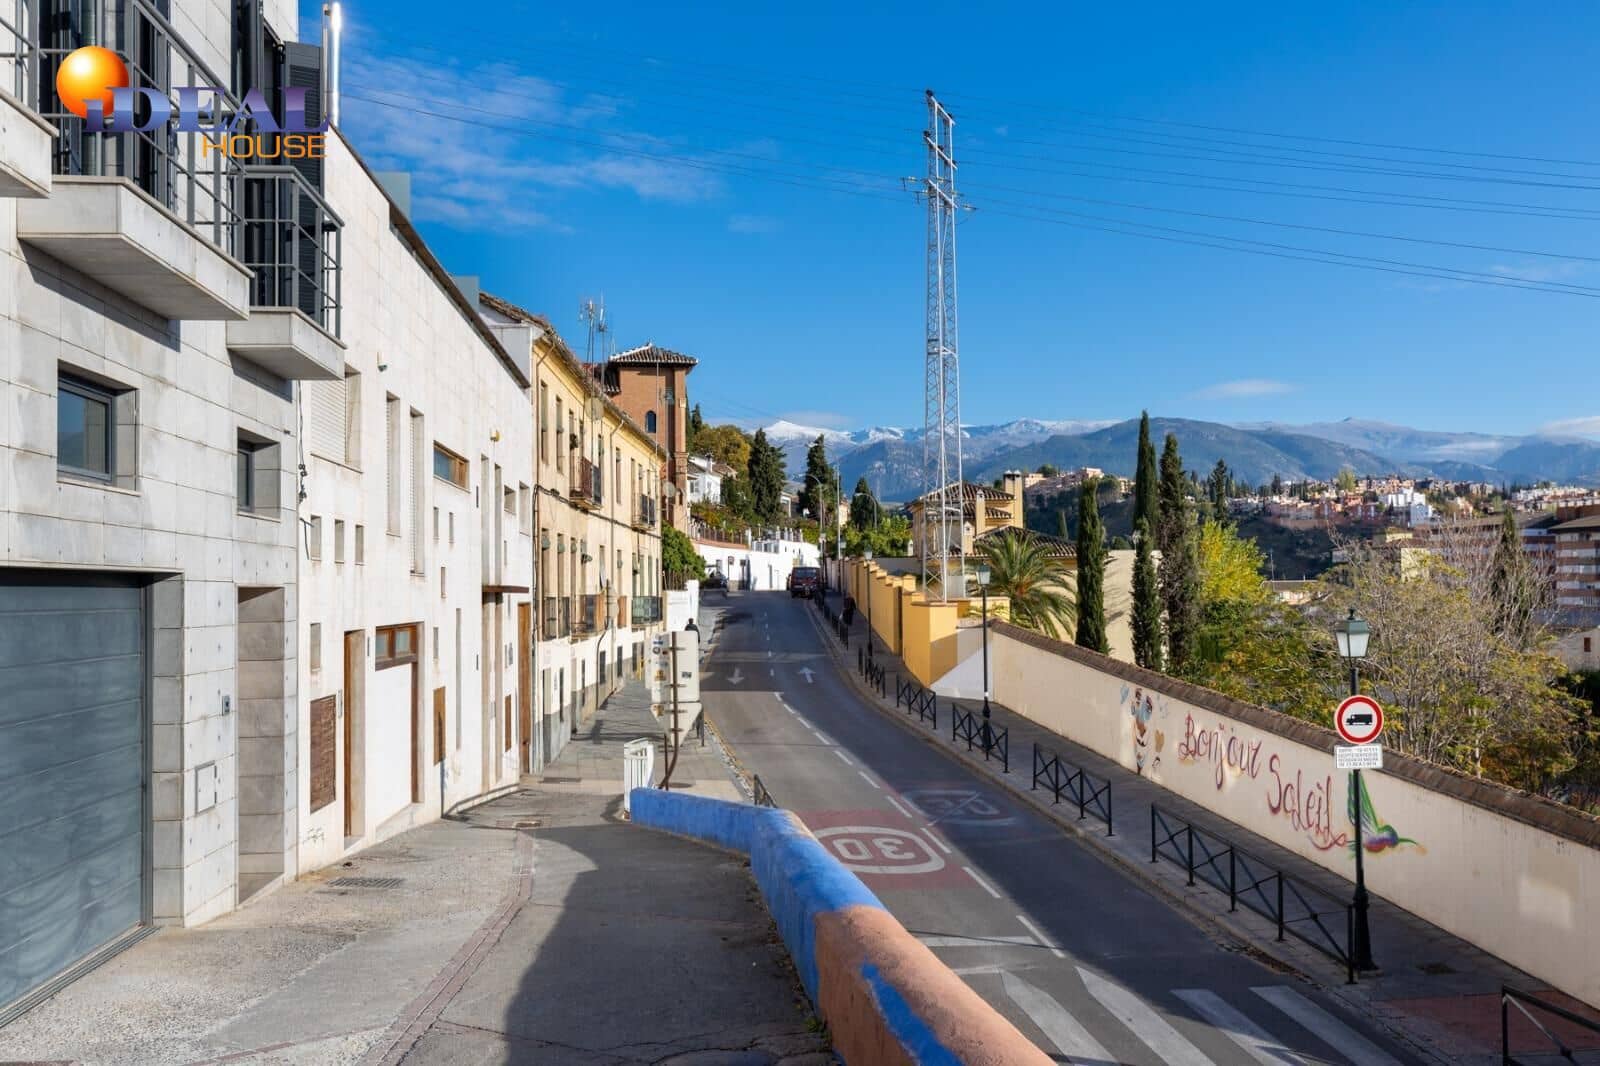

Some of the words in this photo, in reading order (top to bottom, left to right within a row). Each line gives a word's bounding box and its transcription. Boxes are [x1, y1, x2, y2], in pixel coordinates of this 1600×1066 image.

[1178, 713, 1262, 790] Bonjour
[1267, 753, 1336, 844] Soleil
[832, 838, 916, 860] 30
